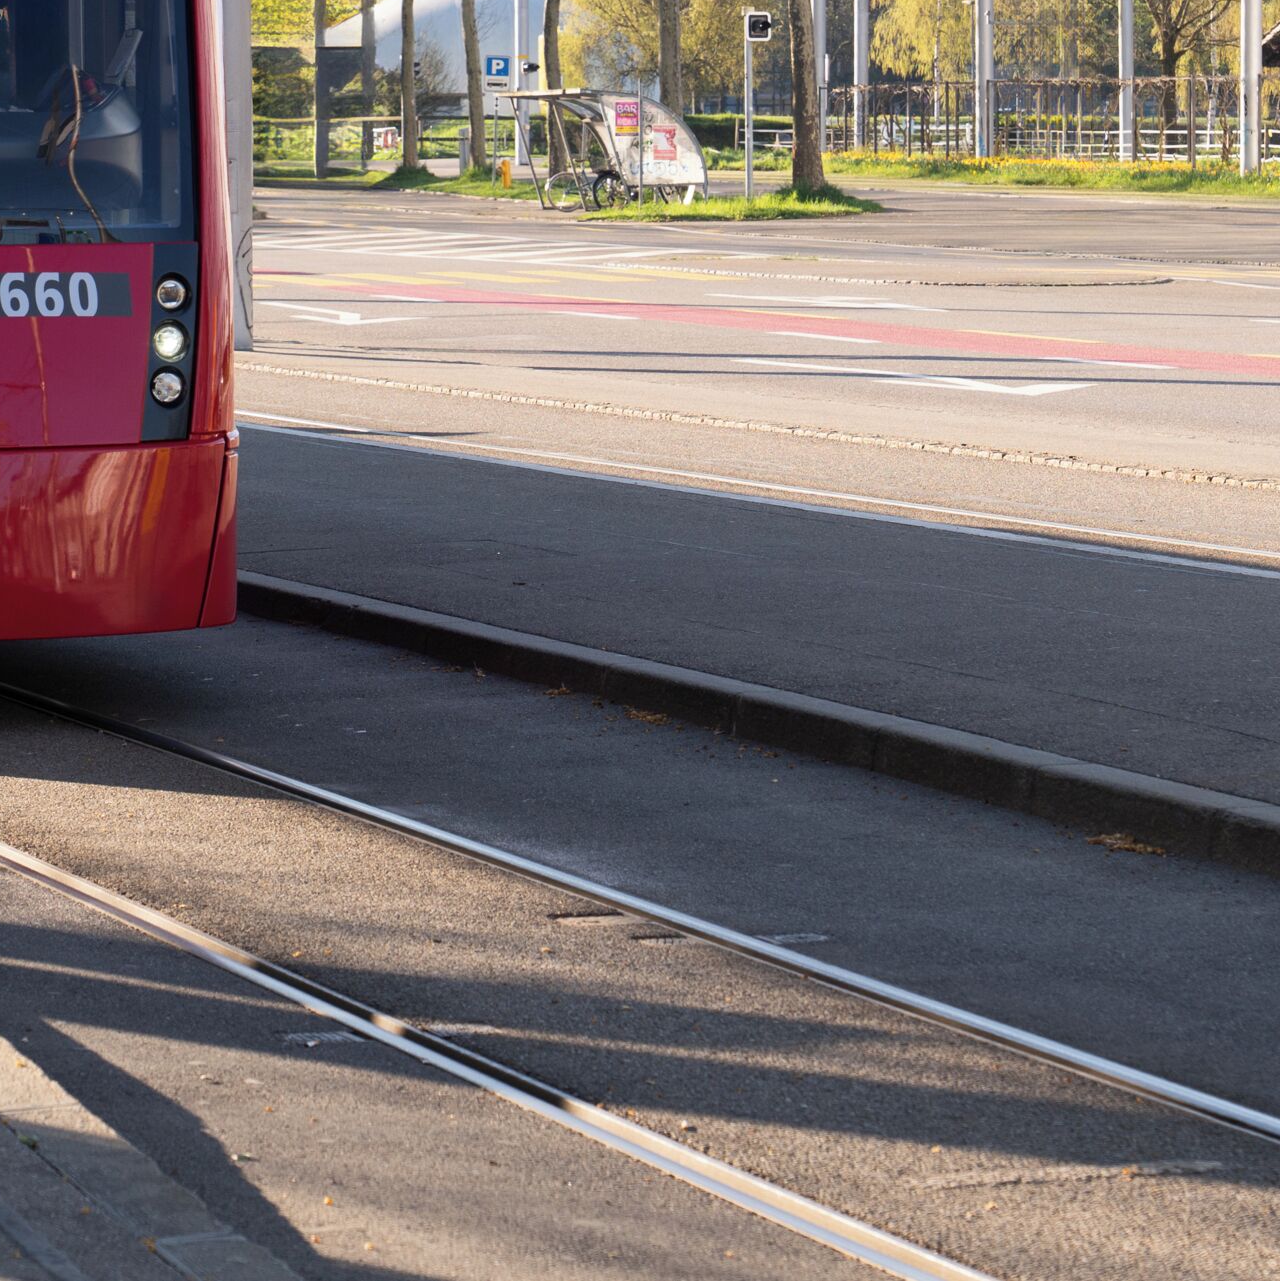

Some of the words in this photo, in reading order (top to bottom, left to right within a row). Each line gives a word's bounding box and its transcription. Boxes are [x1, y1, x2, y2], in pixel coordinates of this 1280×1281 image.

[491, 59, 505, 75] P
[616, 104, 637, 114] BAR
[0, 271, 99, 318] 660
